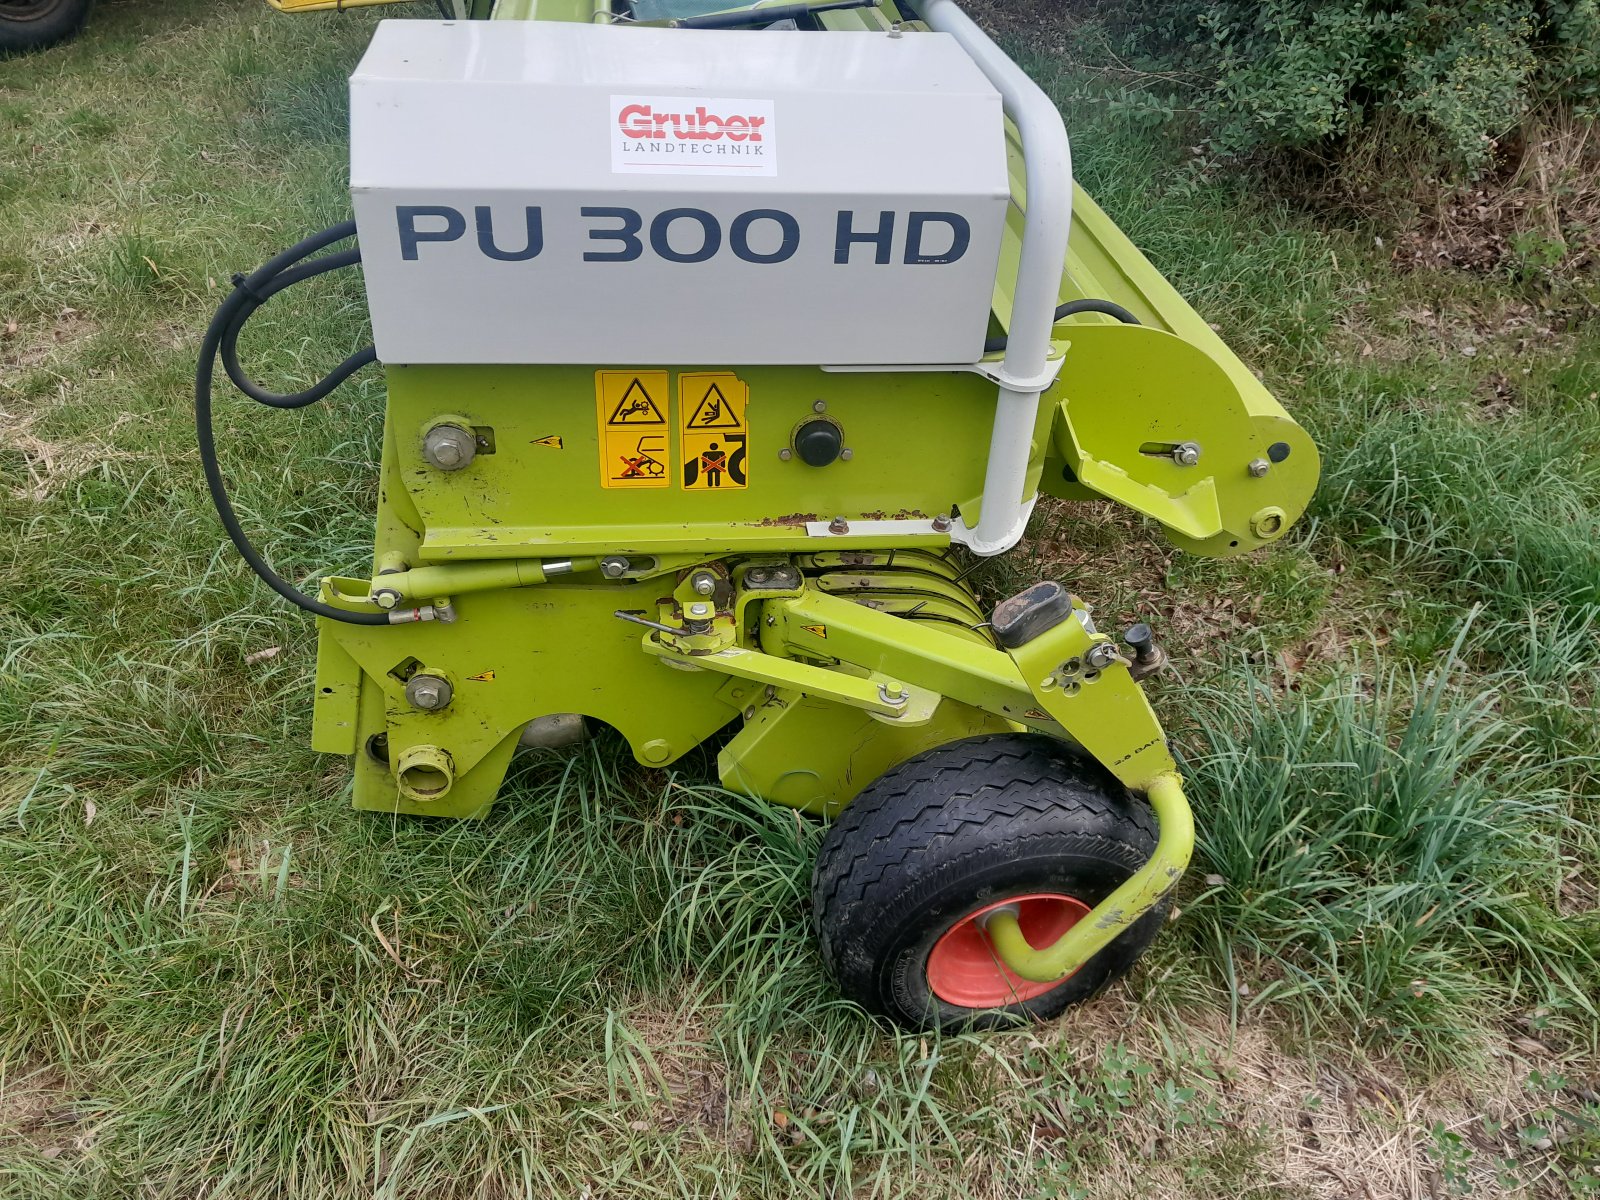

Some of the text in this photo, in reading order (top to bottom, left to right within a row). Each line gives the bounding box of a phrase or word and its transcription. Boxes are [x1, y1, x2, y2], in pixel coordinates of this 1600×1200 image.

[618, 104, 765, 141] Gruber
[623, 142, 763, 155] LANDTECHNIK
[396, 206, 971, 264] PU 300 HD
